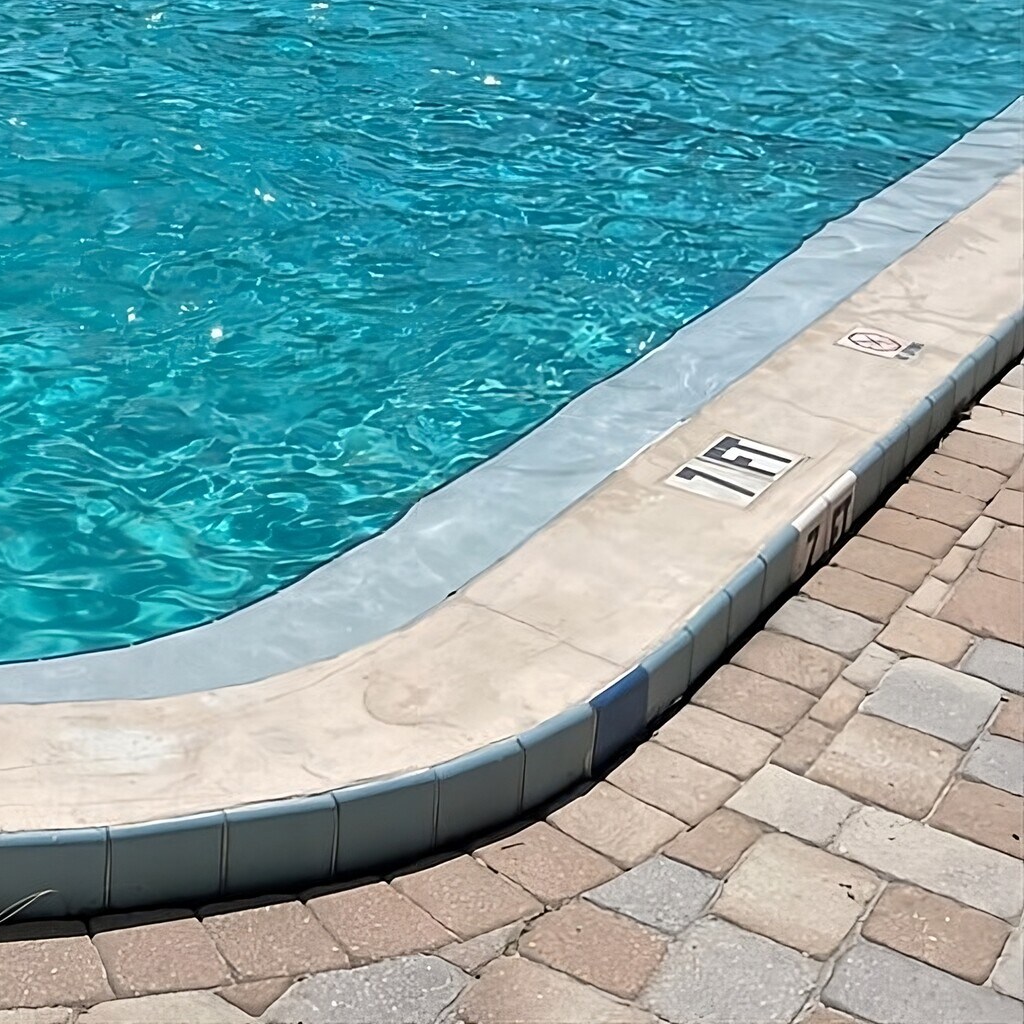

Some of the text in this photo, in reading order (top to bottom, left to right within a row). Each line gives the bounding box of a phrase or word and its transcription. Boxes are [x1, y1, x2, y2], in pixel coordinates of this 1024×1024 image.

[674, 434, 794, 498] 7 FT
[806, 523, 821, 567] 7
